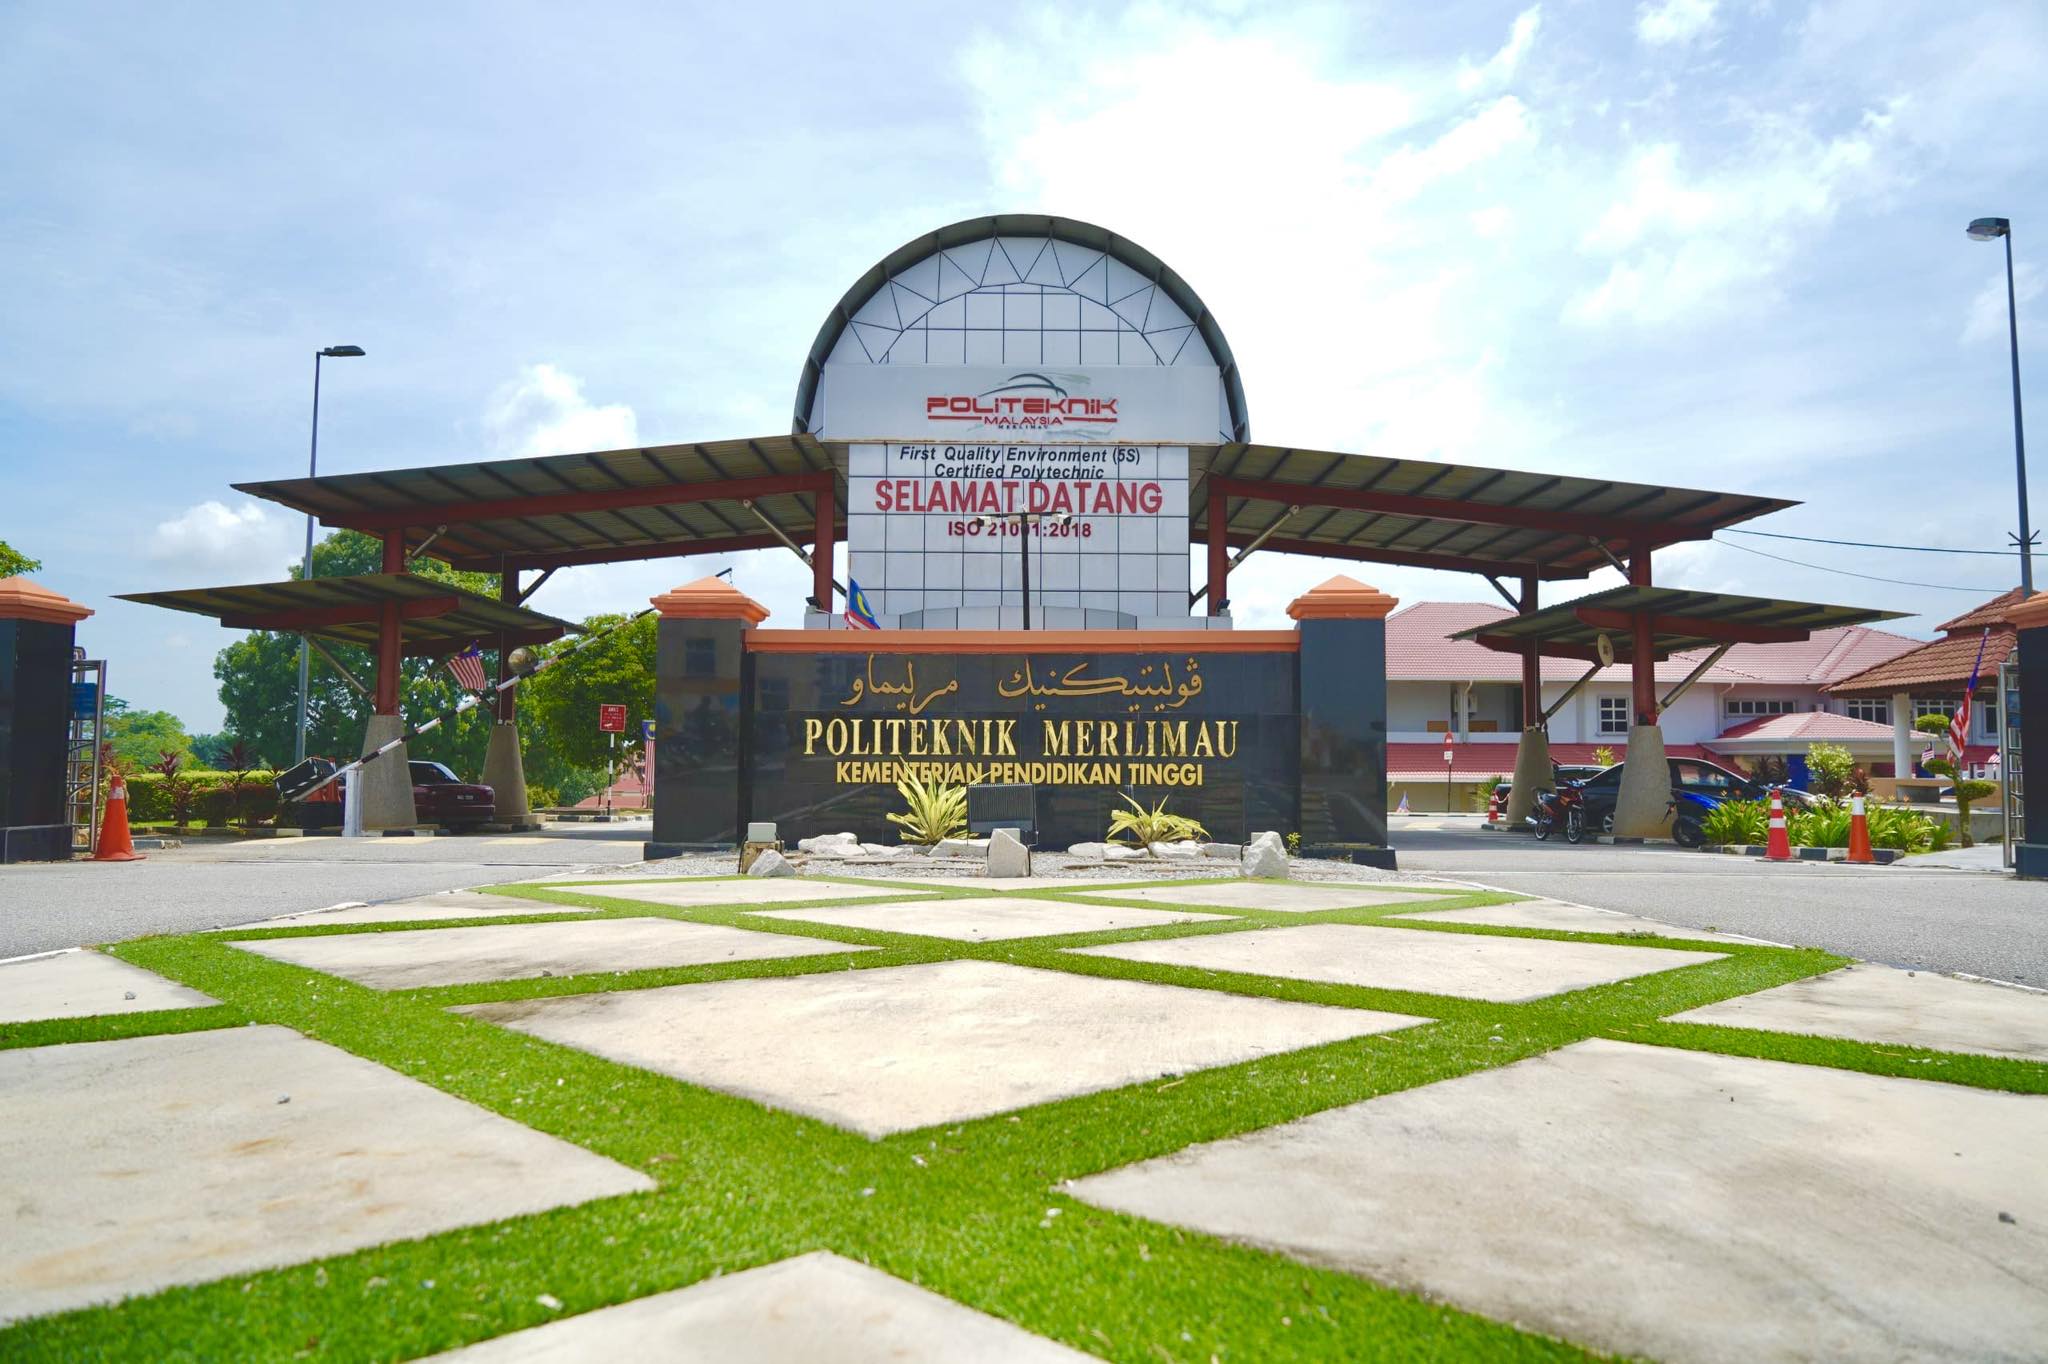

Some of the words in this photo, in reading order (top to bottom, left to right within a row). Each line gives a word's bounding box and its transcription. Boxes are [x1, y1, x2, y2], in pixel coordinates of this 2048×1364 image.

[984, 416, 1063, 425] MALAYSIA
[899, 447, 935, 461] First
[944, 447, 1000, 464] Quality
[1006, 448, 1107, 463] Environment
[1112, 448, 1141, 465] (5S)
[934, 464, 1005, 479] Certified
[1010, 465, 1105, 482] Polytechnic
[875, 479, 1019, 513] SELAMAT
[1028, 481, 1164, 514] DATANG
[948, 520, 981, 537] ISO
[987, 521, 1092, 538] 2101:2018
[803, 718, 1017, 757] POLITEKNIK
[1043, 719, 1240, 758] MERLIMAU
[836, 761, 983, 784] KEMENTERIAN
[990, 762, 1121, 785] PENDIDIKAN
[1128, 763, 1203, 786] TINGGI
